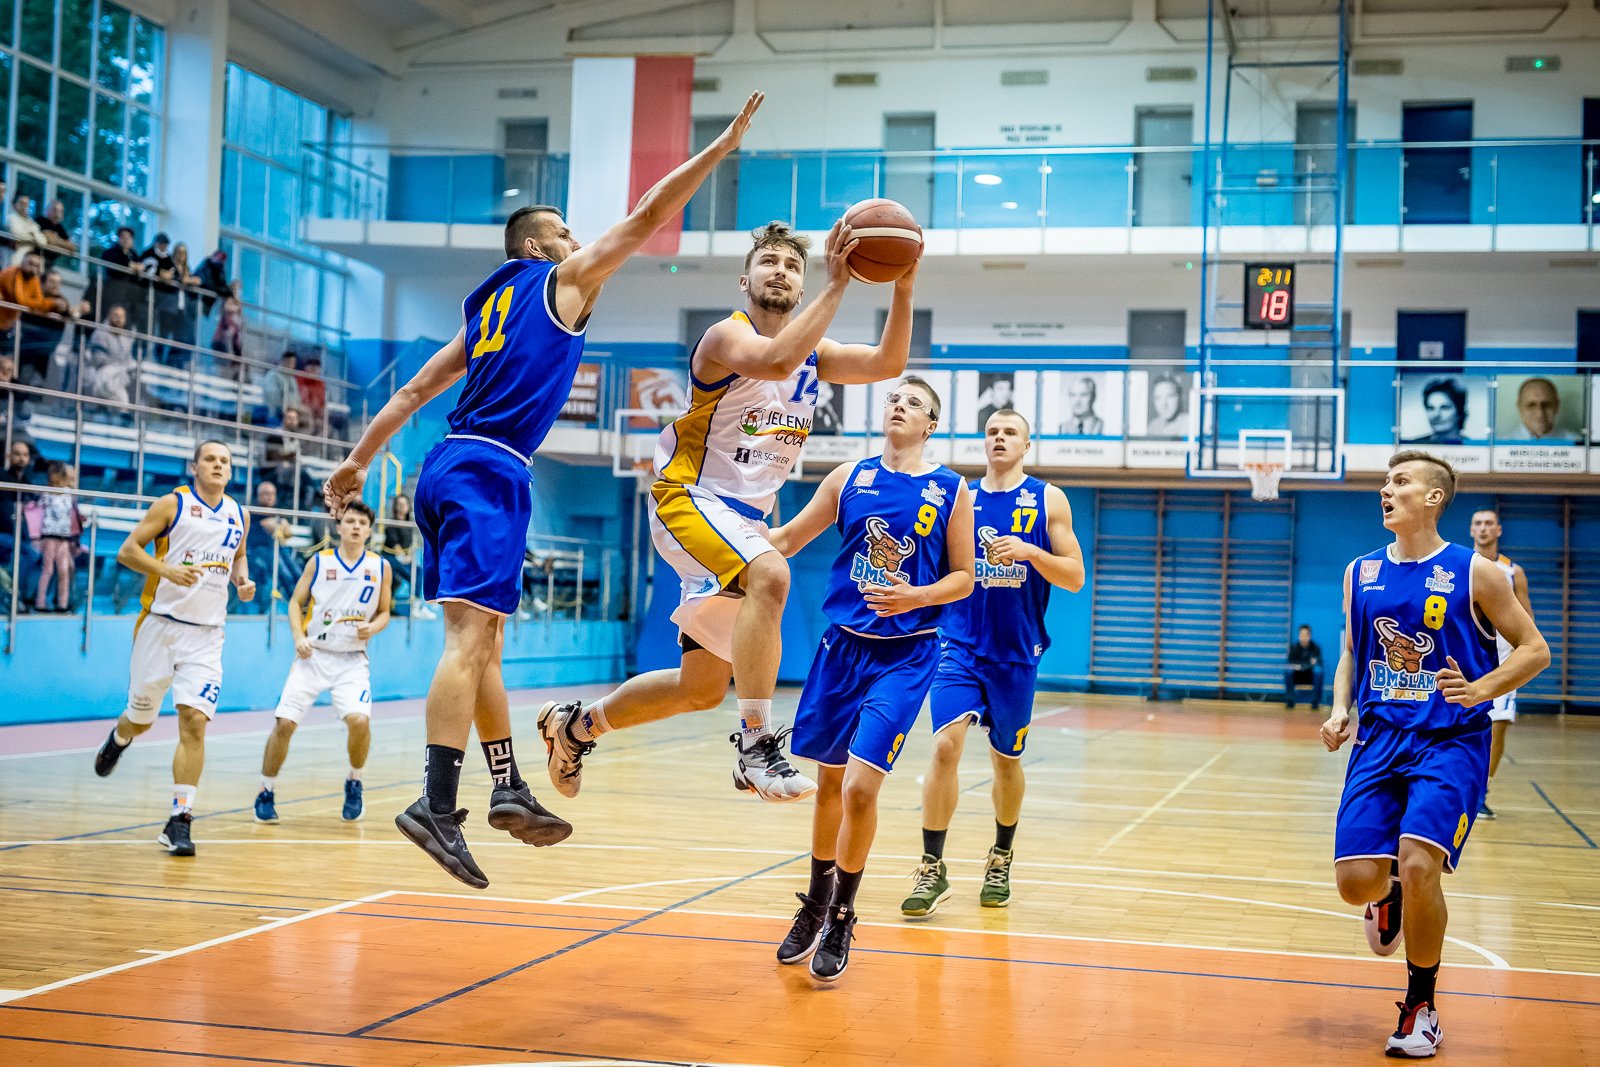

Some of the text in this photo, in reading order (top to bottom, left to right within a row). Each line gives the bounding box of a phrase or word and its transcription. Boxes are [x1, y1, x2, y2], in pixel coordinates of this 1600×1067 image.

[1260, 290, 1289, 321] 18
[472, 286, 515, 359] 11
[788, 369, 819, 406] 14
[752, 449, 763, 460] DR
[914, 503, 938, 537] 9
[1011, 507, 1039, 533] 17
[221, 527, 242, 549] 13
[358, 586, 374, 604] 0
[1424, 595, 1448, 630] 8
[1373, 663, 1436, 690] BMSLAM
[199, 683, 220, 704] 13
[886, 733, 905, 764] 9
[1453, 813, 1469, 849] 8
